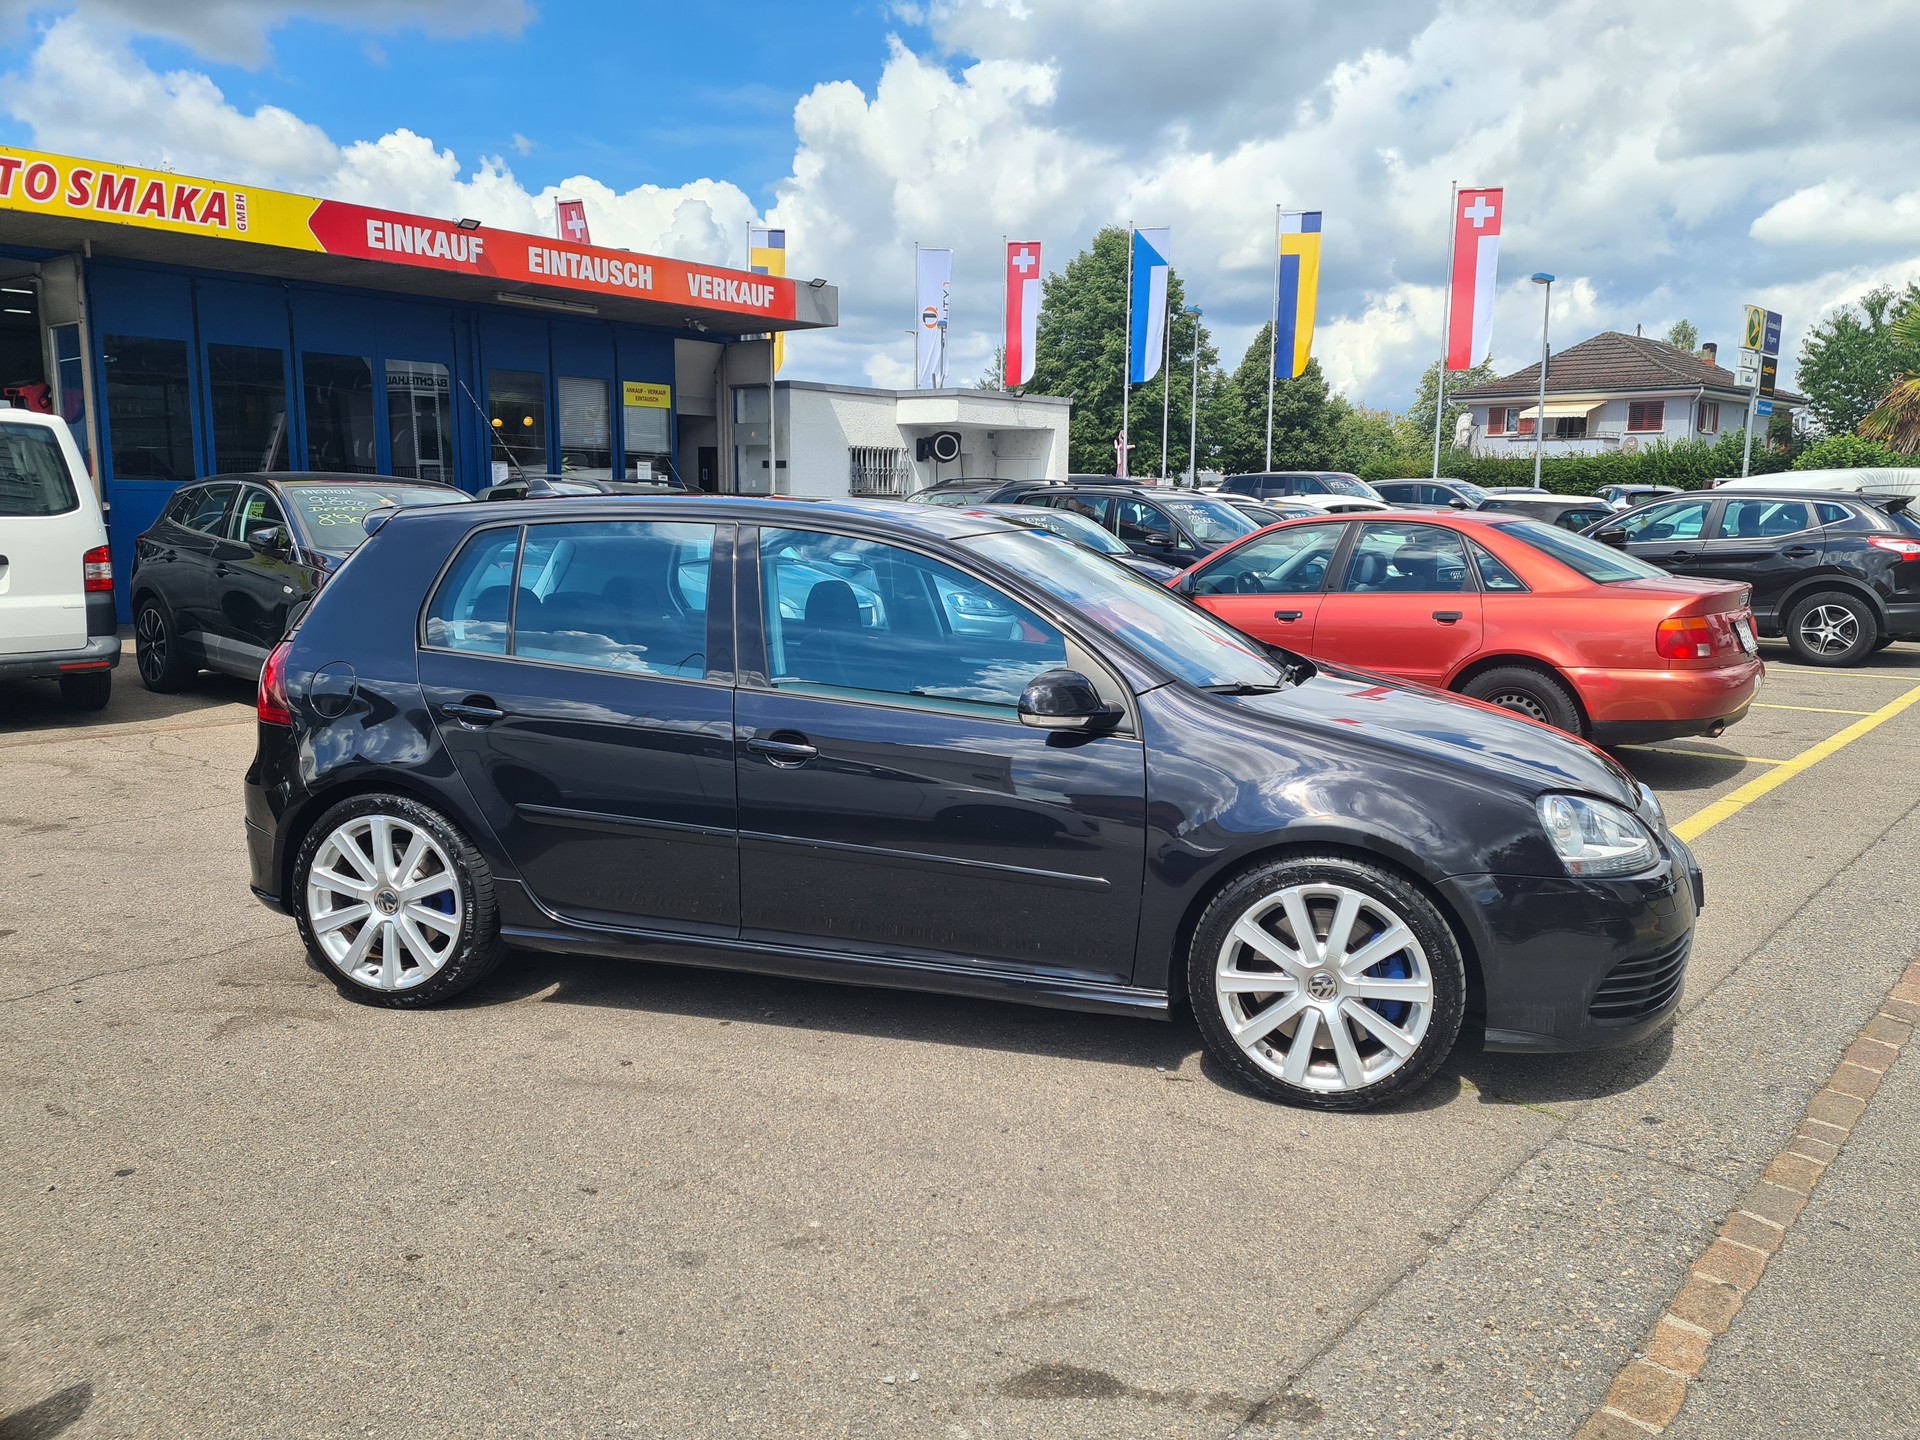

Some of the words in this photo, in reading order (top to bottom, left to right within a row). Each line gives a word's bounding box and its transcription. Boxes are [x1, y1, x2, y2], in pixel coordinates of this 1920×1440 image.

[66, 168, 228, 228] SMAKA
[235, 193, 247, 231] GMBH
[366, 218, 484, 264] EINKAUF
[527, 245, 653, 290] EINTAUSCH
[687, 272, 775, 308] VERKAUF
